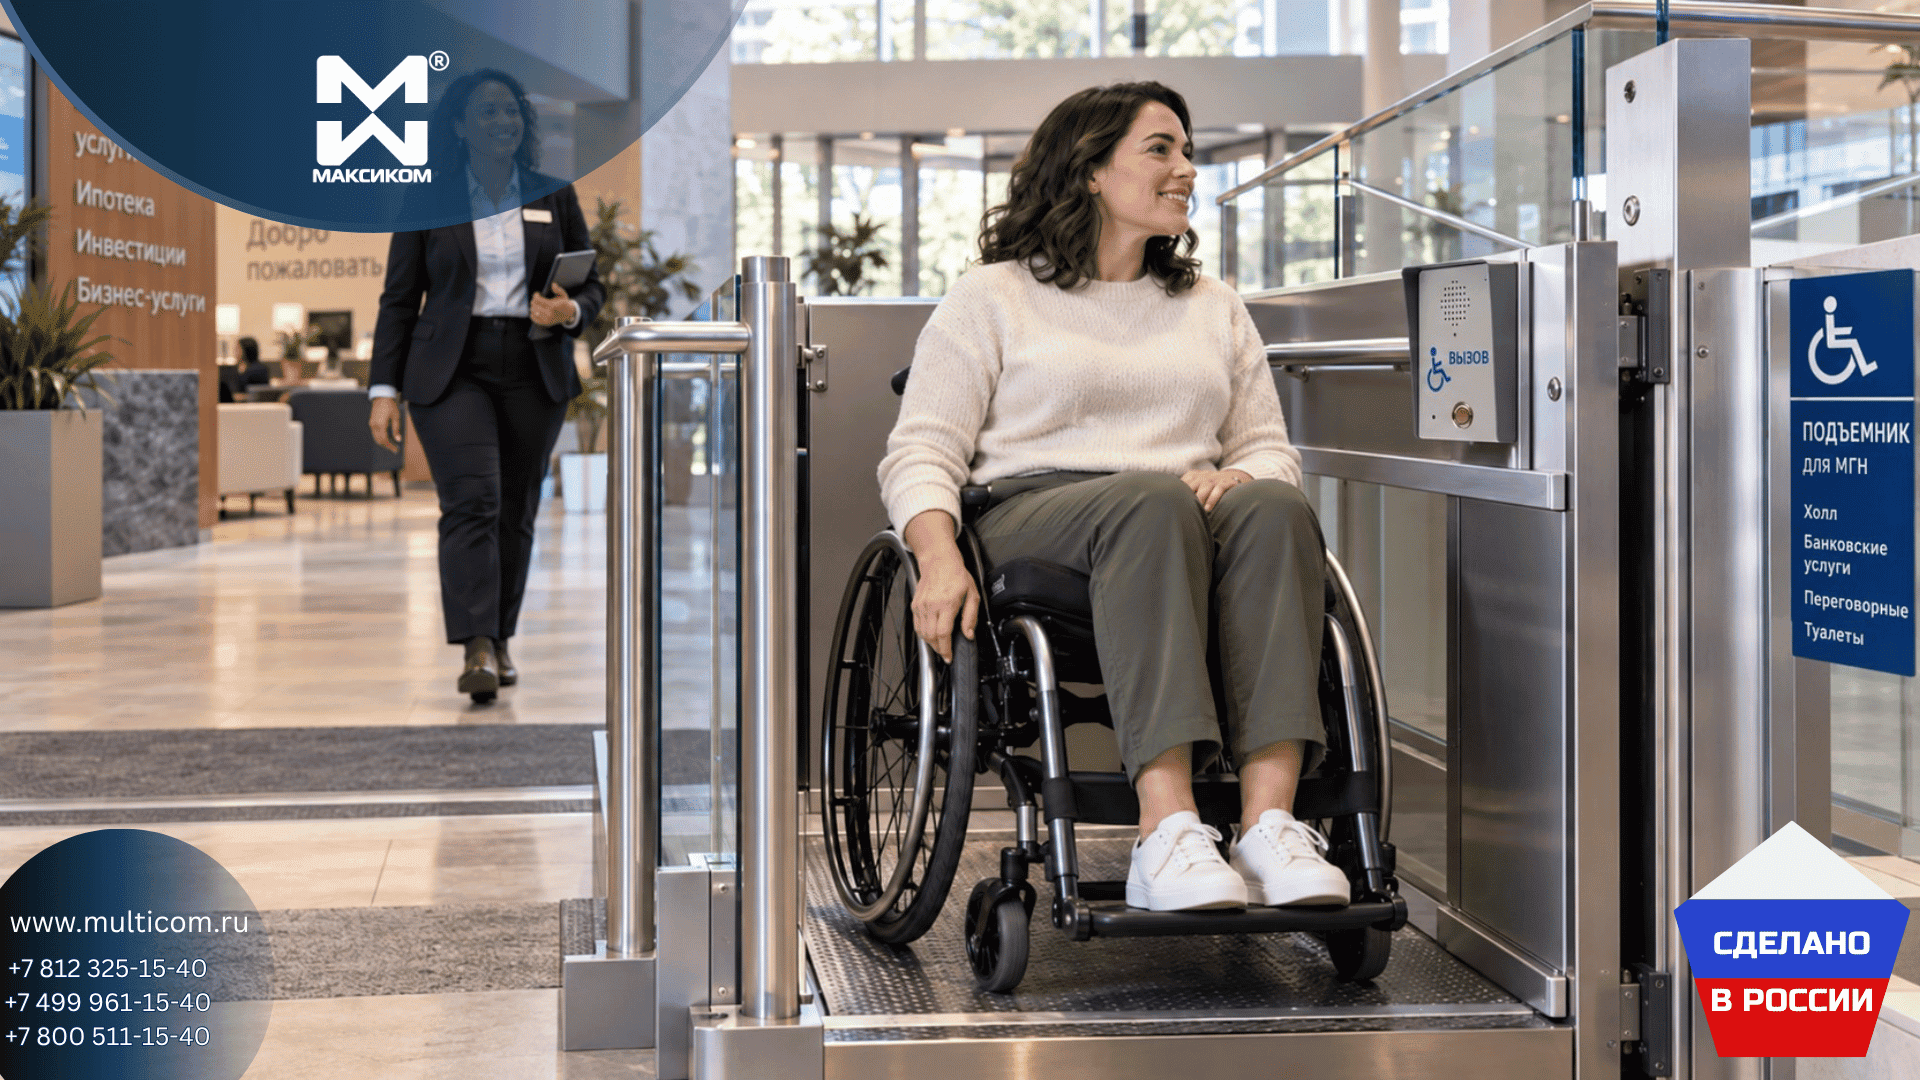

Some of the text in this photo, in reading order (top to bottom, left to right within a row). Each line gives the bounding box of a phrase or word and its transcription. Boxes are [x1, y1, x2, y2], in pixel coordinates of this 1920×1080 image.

[76, 179, 155, 217] Ипотека
[246, 219, 330, 251] Добро
[76, 228, 187, 268] Инвестиции
[246, 256, 383, 281] пожаловать
[77, 275, 206, 317] Бизнес-услуги
[1449, 350, 1490, 365] ВЫЗОВ
[1803, 421, 1911, 446] ПОДЪЕМНИК
[1835, 456, 1868, 475] МГН
[1803, 503, 1838, 521] Холл
[1804, 533, 1888, 556] Банковские
[1803, 559, 1851, 577] услуги
[1804, 589, 1909, 619] Переговорные
[1804, 621, 1864, 645] Туалеты
